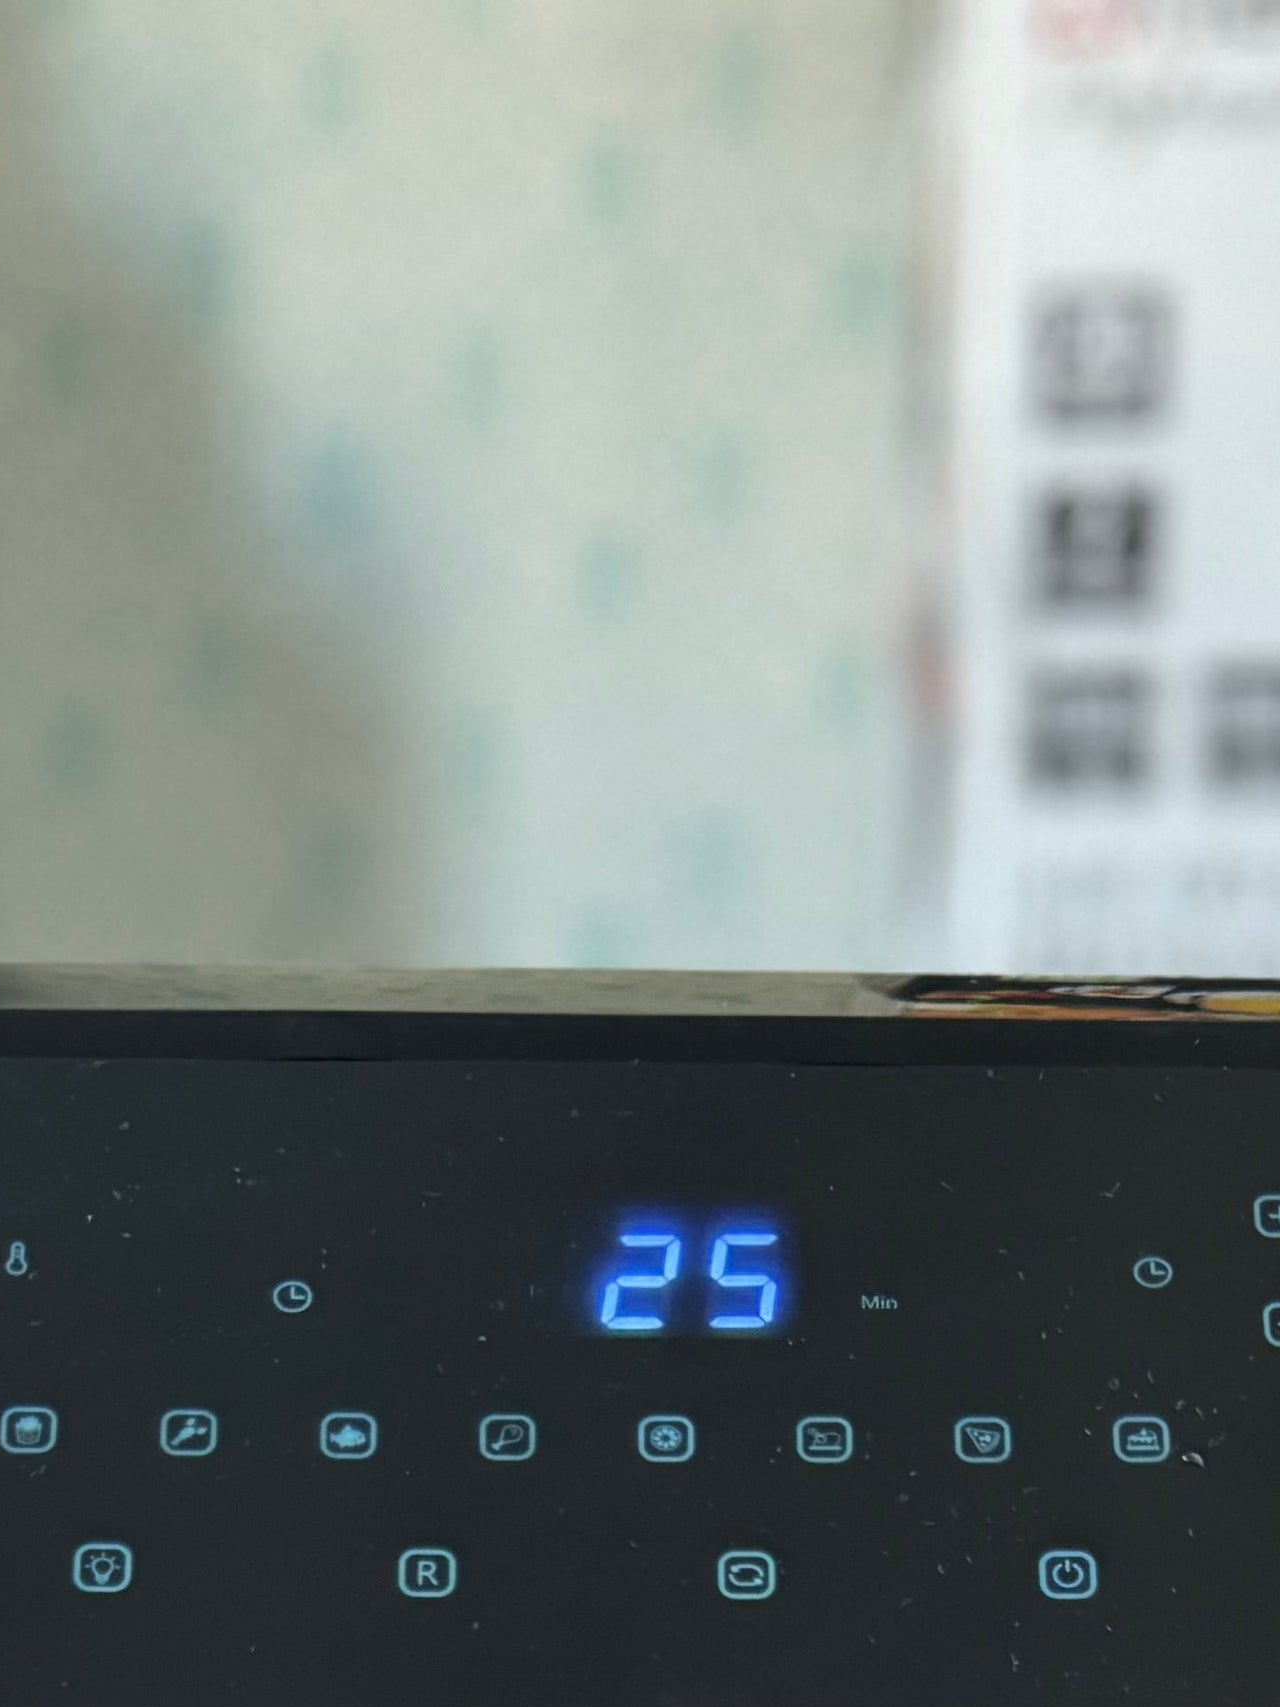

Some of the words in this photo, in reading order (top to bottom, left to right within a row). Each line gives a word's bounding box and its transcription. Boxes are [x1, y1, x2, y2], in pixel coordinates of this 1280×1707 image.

[601, 1233, 779, 1330] 25
[860, 1294, 899, 1310] Min
[417, 1560, 439, 1586] R
